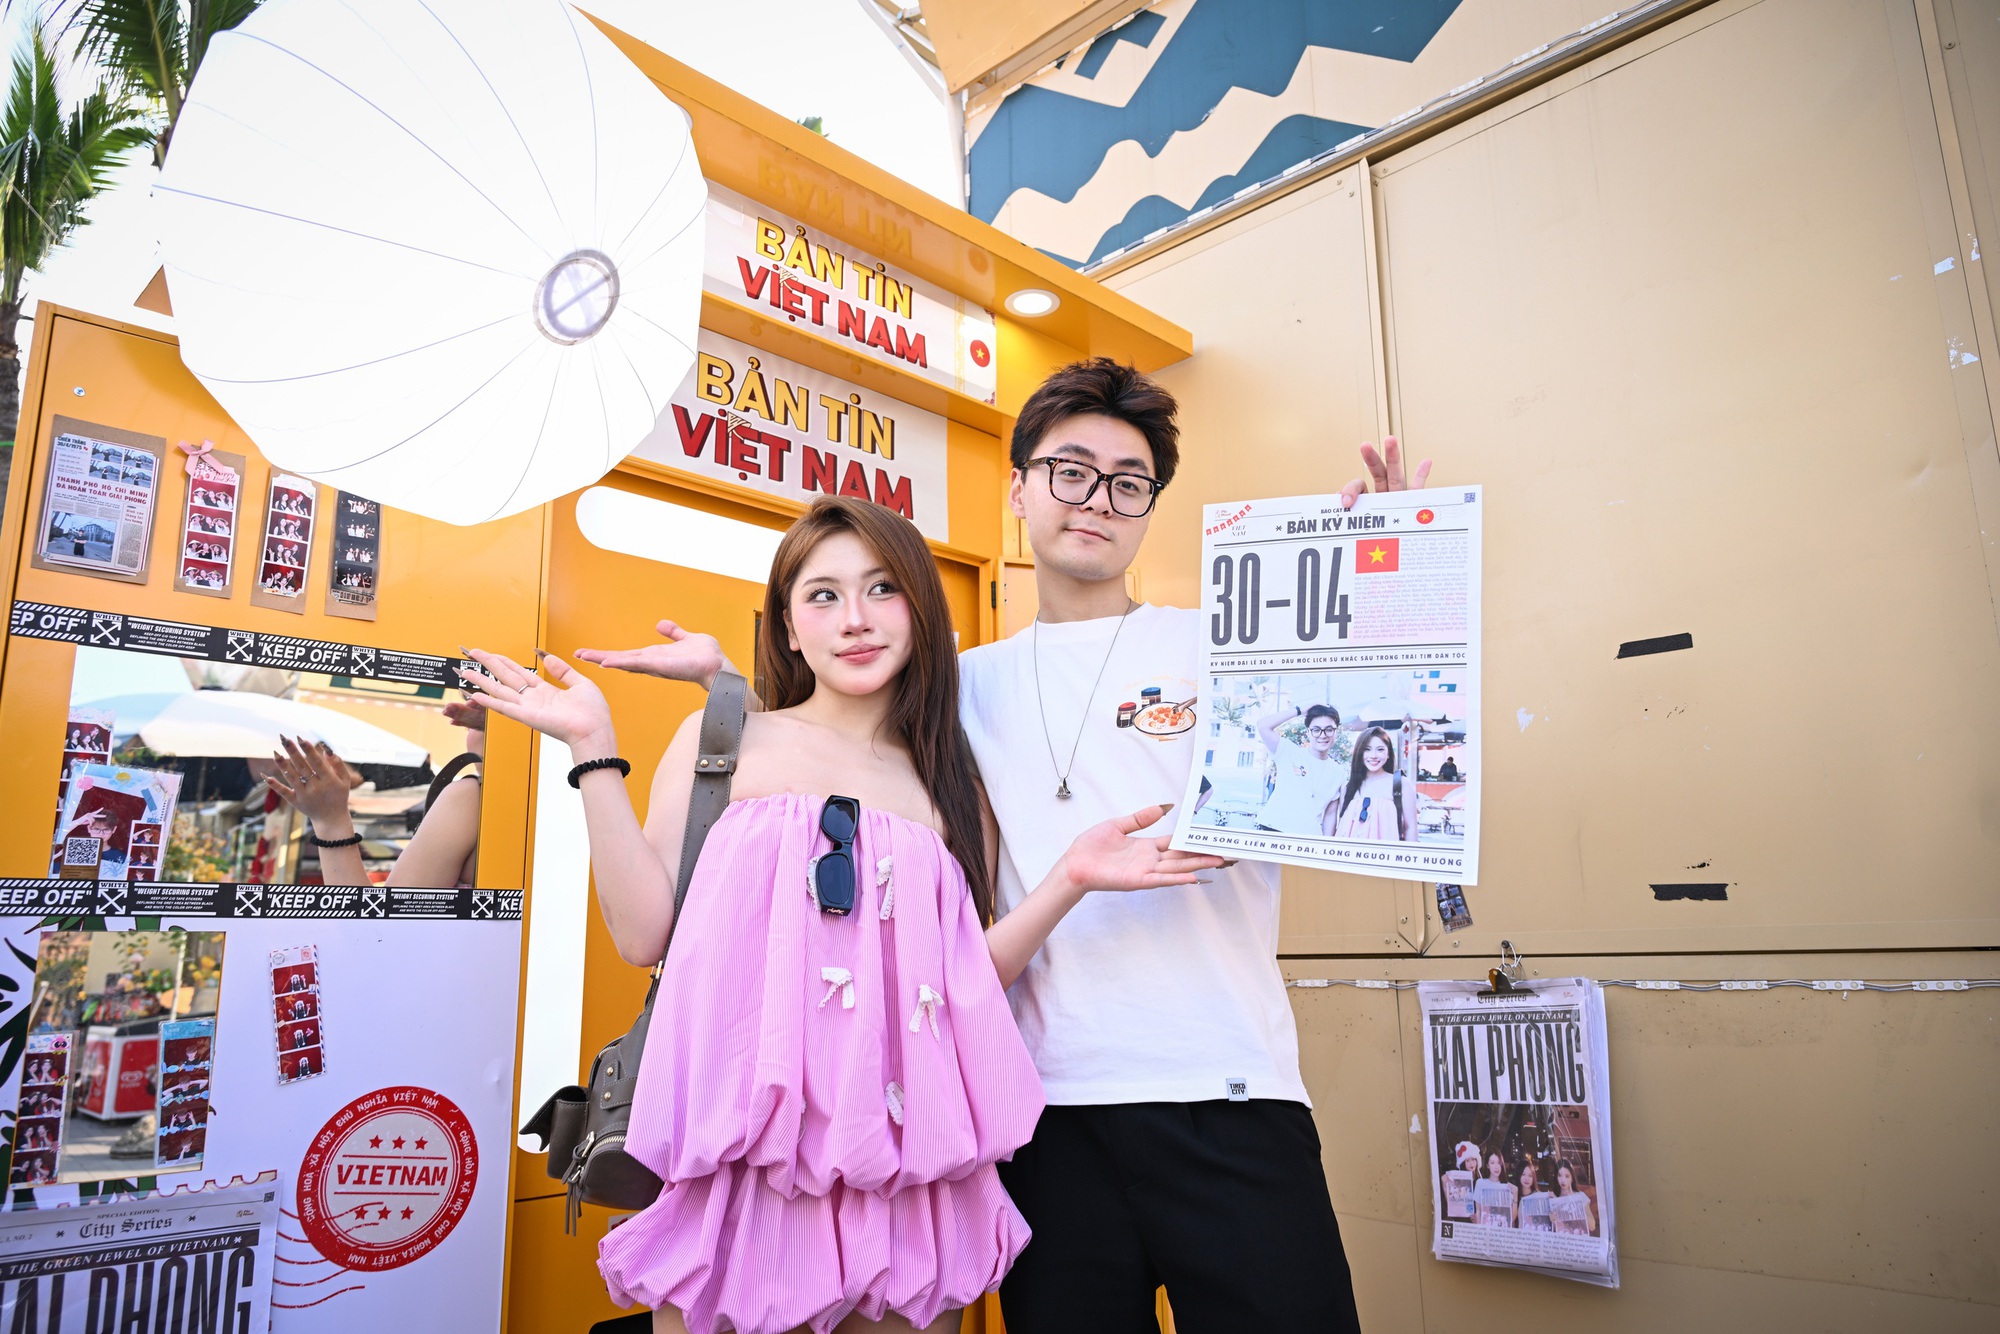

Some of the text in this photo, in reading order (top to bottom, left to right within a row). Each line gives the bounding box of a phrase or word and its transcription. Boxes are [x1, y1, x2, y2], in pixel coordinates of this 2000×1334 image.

[756, 216, 845, 290] BẢN
[838, 299, 928, 369] NAM
[697, 350, 809, 433] BẢN
[802, 444, 914, 520] NAM
[1286, 512, 1386, 534] BẢN KỶ NIỆM
[40, 614, 87, 632] OFF"
[94, 613, 122, 622] WHITE
[128, 622, 154, 631] "WEIGHT
[154, 626, 183, 634] SECURING
[259, 642, 348, 664] "KEEP OFF"
[0, 889, 92, 905] EEP OFF"
[267, 894, 358, 909] "KEEP OFF"
[1431, 1022, 1586, 1104] HAI PHONG
[337, 1164, 448, 1186] VIETNAM
[80, 1217, 173, 1238] City Series
[9, 1236, 231, 1275] THE GREEN JEWEL OF VIETNAM
